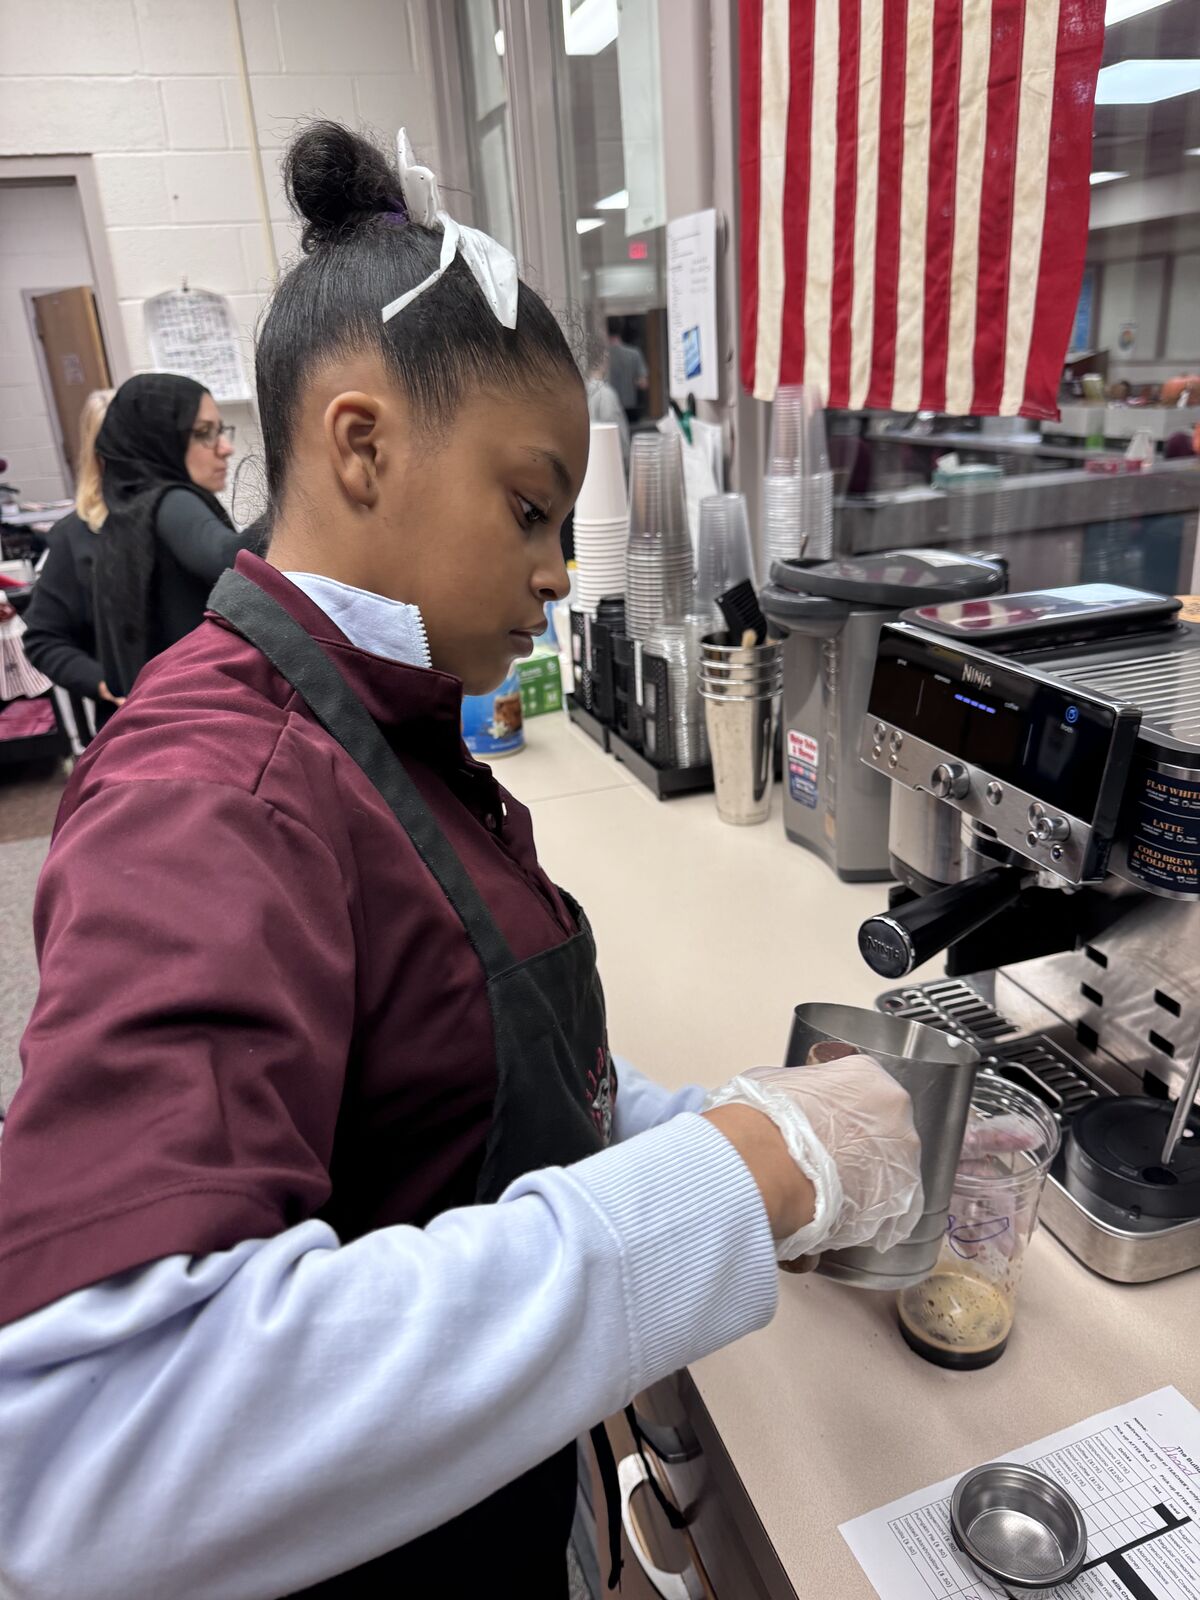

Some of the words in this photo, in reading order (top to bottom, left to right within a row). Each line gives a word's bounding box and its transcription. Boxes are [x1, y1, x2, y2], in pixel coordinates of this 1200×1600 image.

[962, 664, 992, 690] NINJA
[1146, 779, 1168, 793] FLAT
[1152, 819, 1184, 833] LATTE
[1138, 844, 1161, 859] COLD
[1162, 854, 1194, 867] BREW
[1141, 854, 1166, 868] COLD
[1166, 863, 1198, 875] FOAM
[1114, 1425, 1123, 1434] Pick
[1128, 1440, 1142, 1453] AFTER
[1140, 1453, 1150, 1462] 2nd
[1117, 1447, 1131, 1461] Drinks
[1175, 1446, 1187, 1457] The
[1152, 1485, 1161, 1494] Hot
[1159, 1474, 1170, 1484] Pick
[1174, 1491, 1190, 1505] AFTER
[1168, 1503, 1180, 1514] Iced
